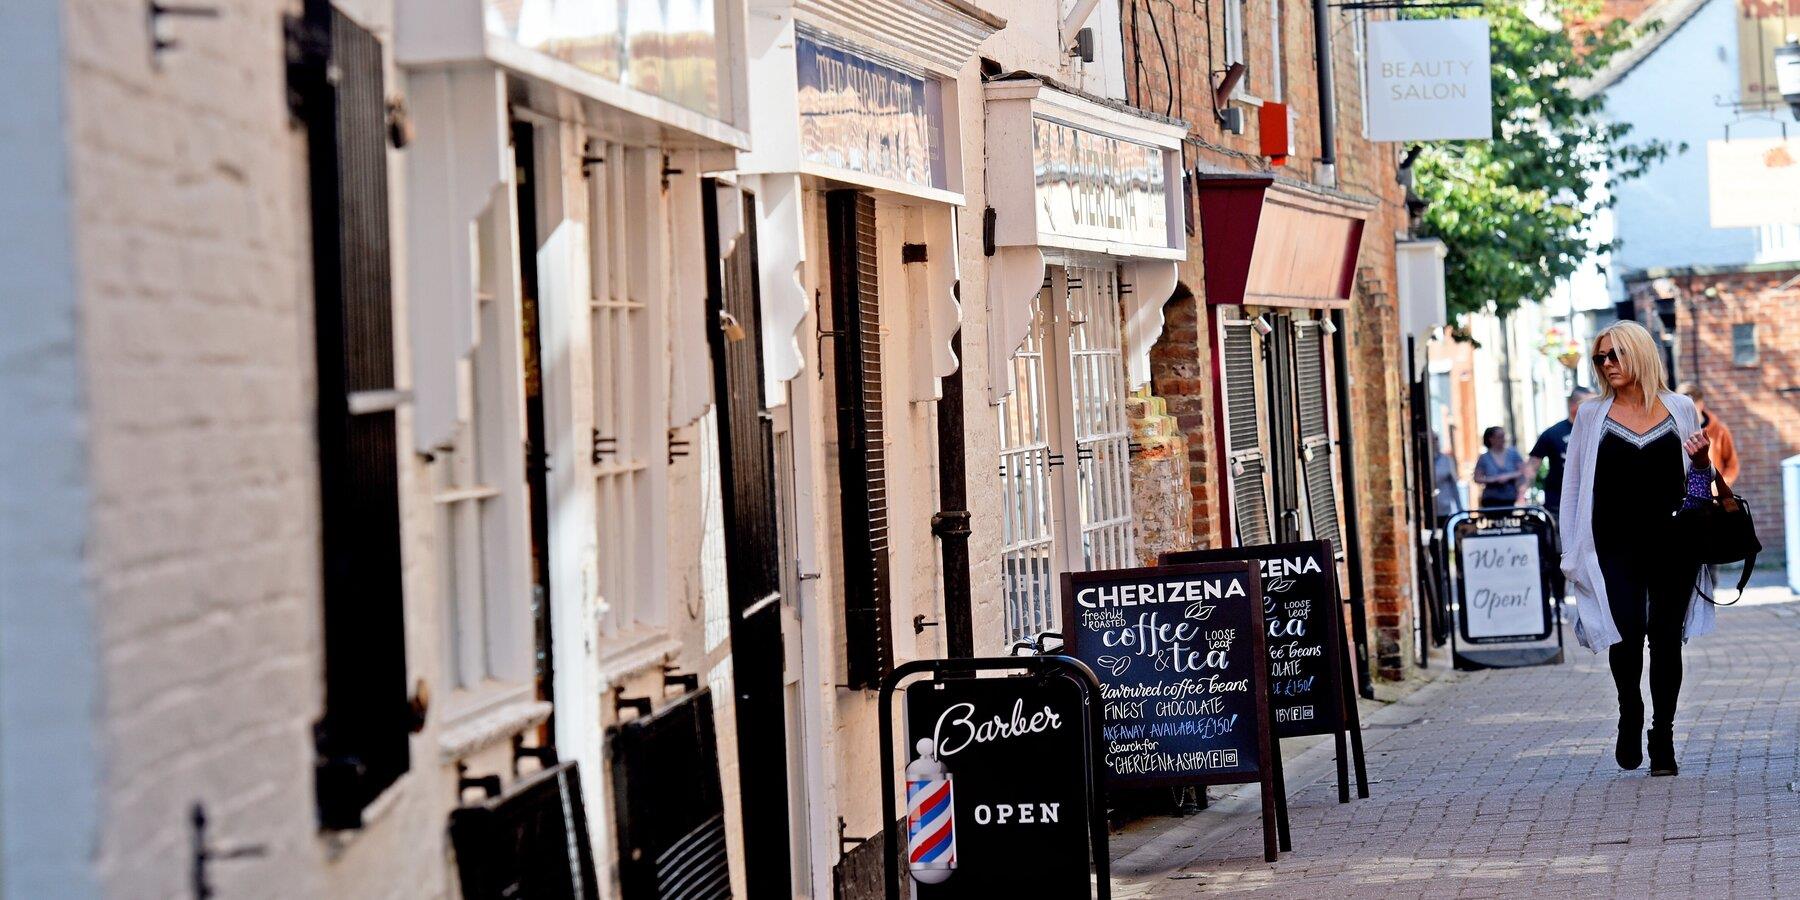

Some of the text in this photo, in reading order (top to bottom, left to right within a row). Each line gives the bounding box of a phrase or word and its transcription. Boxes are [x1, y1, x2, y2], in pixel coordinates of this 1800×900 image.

[1381, 60, 1473, 78] BEAUTY
[815, 53, 912, 130] THE SHORT CUT
[1391, 83, 1467, 100] SALON
[1068, 143, 1138, 231] CHERIZENA
[1469, 547, 1529, 569] We're
[1077, 578, 1247, 608] CHERIZENA
[1284, 600, 1312, 609] LOOSE
[1473, 587, 1531, 619] Open!
[1082, 607, 1123, 627] freshly
[1088, 618, 1127, 632] ROASTED
[1102, 611, 1200, 657] coffee
[1205, 628, 1236, 640] LOOSE
[1154, 641, 1229, 673] & tea
[1281, 641, 1322, 658] beans
[1163, 678, 1206, 700] coffee
[1198, 674, 1249, 694] beans
[1104, 695, 1225, 720] FINEST CHOCOLATE
[932, 697, 1062, 762] Barber
[1103, 723, 1146, 741] AKEAWAY
[1149, 718, 1206, 738] AVAILABLE
[974, 803, 1060, 825] OPEN
